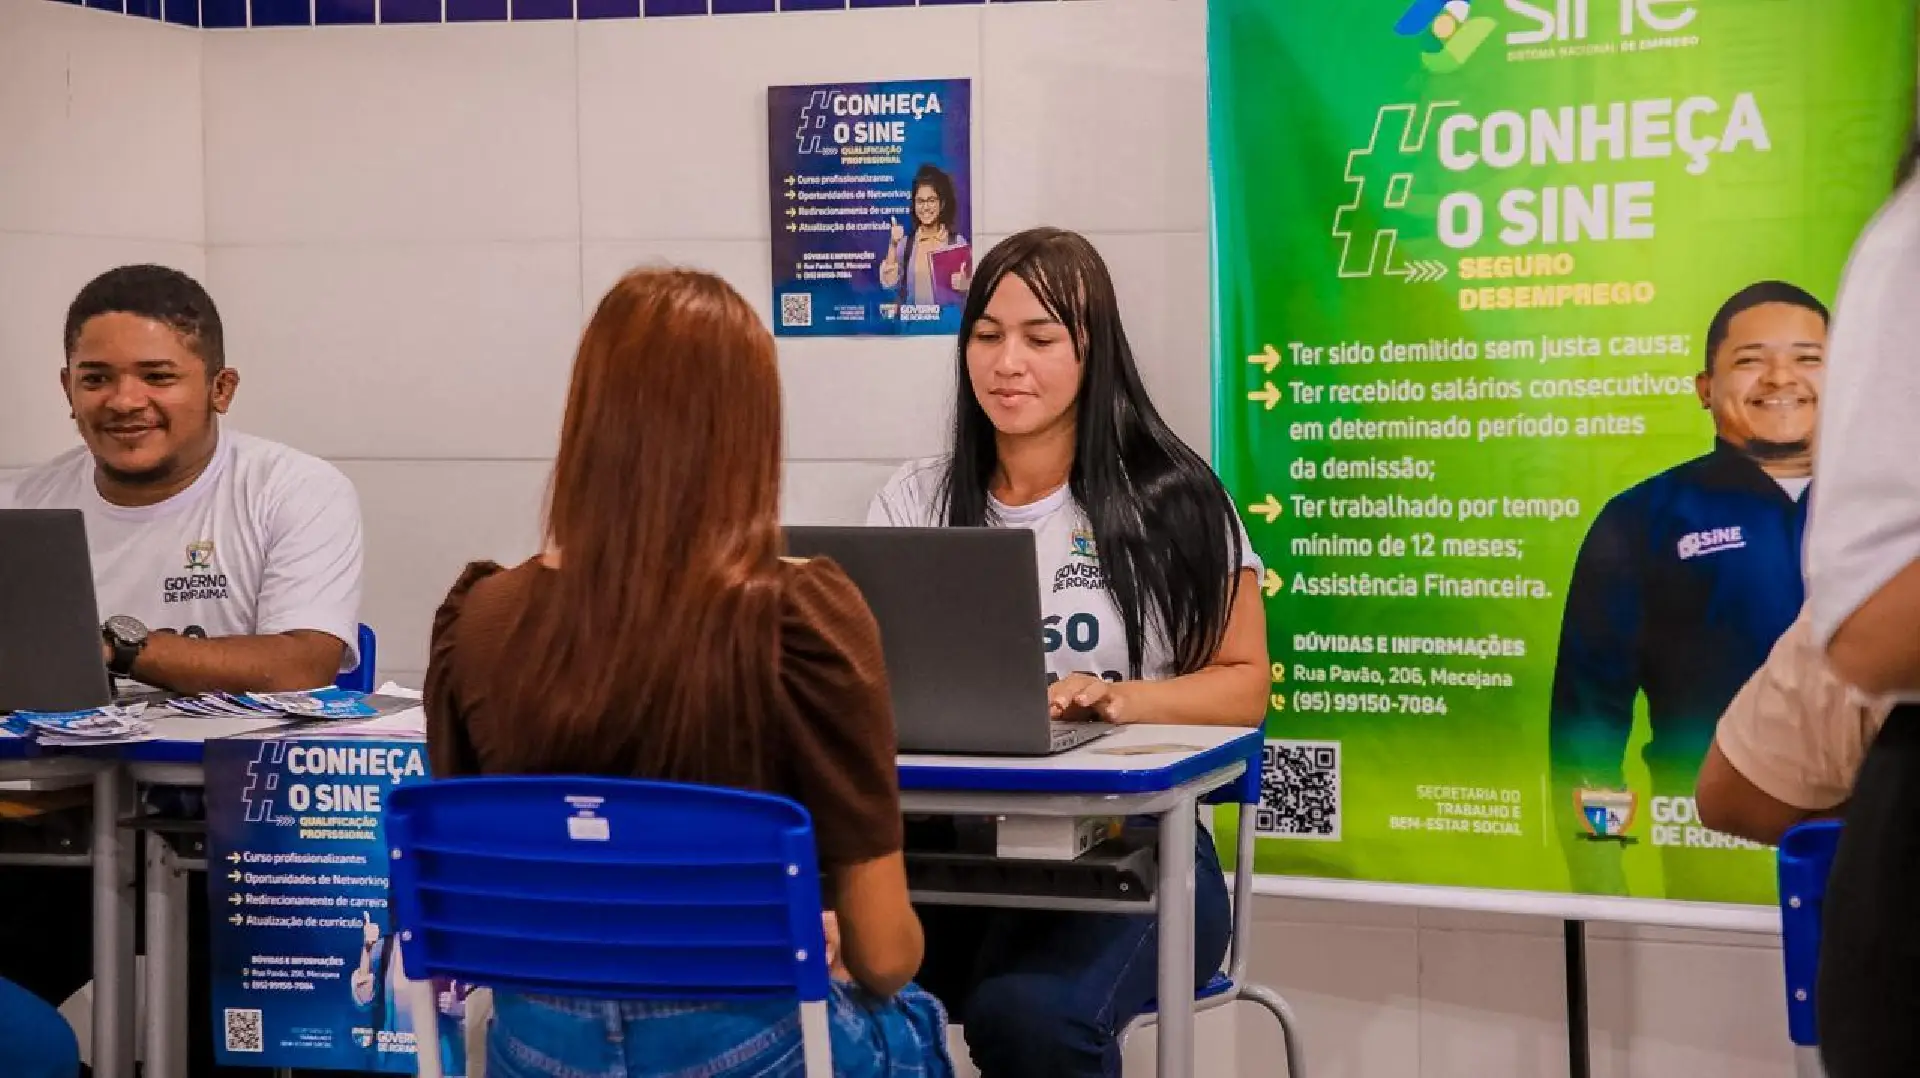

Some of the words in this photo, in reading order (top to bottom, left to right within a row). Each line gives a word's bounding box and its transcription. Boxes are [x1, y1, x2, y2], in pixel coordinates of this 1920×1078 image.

[1620, 40, 1637, 53] DE
[834, 93, 943, 120] CONHEÇA
[833, 122, 850, 144] O
[854, 121, 905, 143] SINE
[1437, 93, 1771, 175] CONHEÇA
[856, 190, 866, 200] de
[1437, 191, 1484, 249] O
[1499, 181, 1655, 246] SINE
[1459, 252, 1575, 279] SEGURO
[1459, 281, 1655, 310] DESEMPREGO
[1288, 343, 1321, 366] Ter
[1328, 341, 1376, 365] sido
[1380, 338, 1478, 363] demitido
[1485, 340, 1535, 359] sem
[1539, 336, 1601, 363] justa
[1609, 335, 1692, 357] causa;
[1288, 381, 1324, 404] Ter
[1328, 379, 1426, 404] recebido
[1431, 377, 1523, 400] salários
[1530, 374, 1696, 398] consecutivos
[1290, 421, 1324, 441] em
[1328, 416, 1471, 440] determinado
[1478, 414, 1569, 443] período
[1575, 415, 1645, 436] antes
[1290, 457, 1317, 480] da
[1322, 454, 1436, 481] demissão;
[1290, 495, 1324, 519] Ter
[1329, 493, 1453, 519] trabalhado
[1458, 497, 1497, 522] por
[1503, 495, 1580, 522] tempo
[1291, 533, 1373, 557] mínimo
[1377, 534, 1405, 557] de
[1411, 533, 1436, 557] 12
[1442, 538, 1524, 560] meses;
[1701, 526, 1743, 546] SINE
[164, 574, 227, 591] GOVERNO
[1291, 571, 1418, 597] Assistência
[1424, 573, 1552, 599] Financeira.
[164, 591, 178, 603] DE
[1293, 630, 1375, 653] DÚVIDAS
[1377, 636, 1388, 653] E
[1391, 633, 1526, 659] INFORMAÇÕES
[1293, 664, 1326, 683] Rua
[1330, 664, 1385, 685] Pavão,
[1389, 666, 1427, 686] 206,
[1430, 668, 1513, 690] Mecejana
[1293, 694, 1331, 713] (95)
[1334, 694, 1448, 714] 99150-7084
[287, 747, 425, 785] CONHEÇA
[288, 784, 311, 812] O
[315, 784, 382, 812] SINE
[1416, 784, 1498, 802] SECRETARIA
[1500, 788, 1521, 803] DO
[300, 815, 378, 829] QUALIFICAÇÃO
[1437, 801, 1510, 818] TRABALHO
[1512, 805, 1522, 819] E
[1390, 815, 1470, 832] BEM-ESTAR
[1472, 819, 1523, 836] SOCIAL
[1651, 825, 1682, 847] DE
[243, 851, 272, 864] Curso
[273, 852, 367, 866] profissionalizantes
[245, 872, 317, 886] Oportunidades
[318, 874, 331, 885] de
[332, 873, 389, 889] Networking
[336, 895, 349, 906] de
[350, 897, 388, 908] carreira
[305, 916, 318, 927] de
